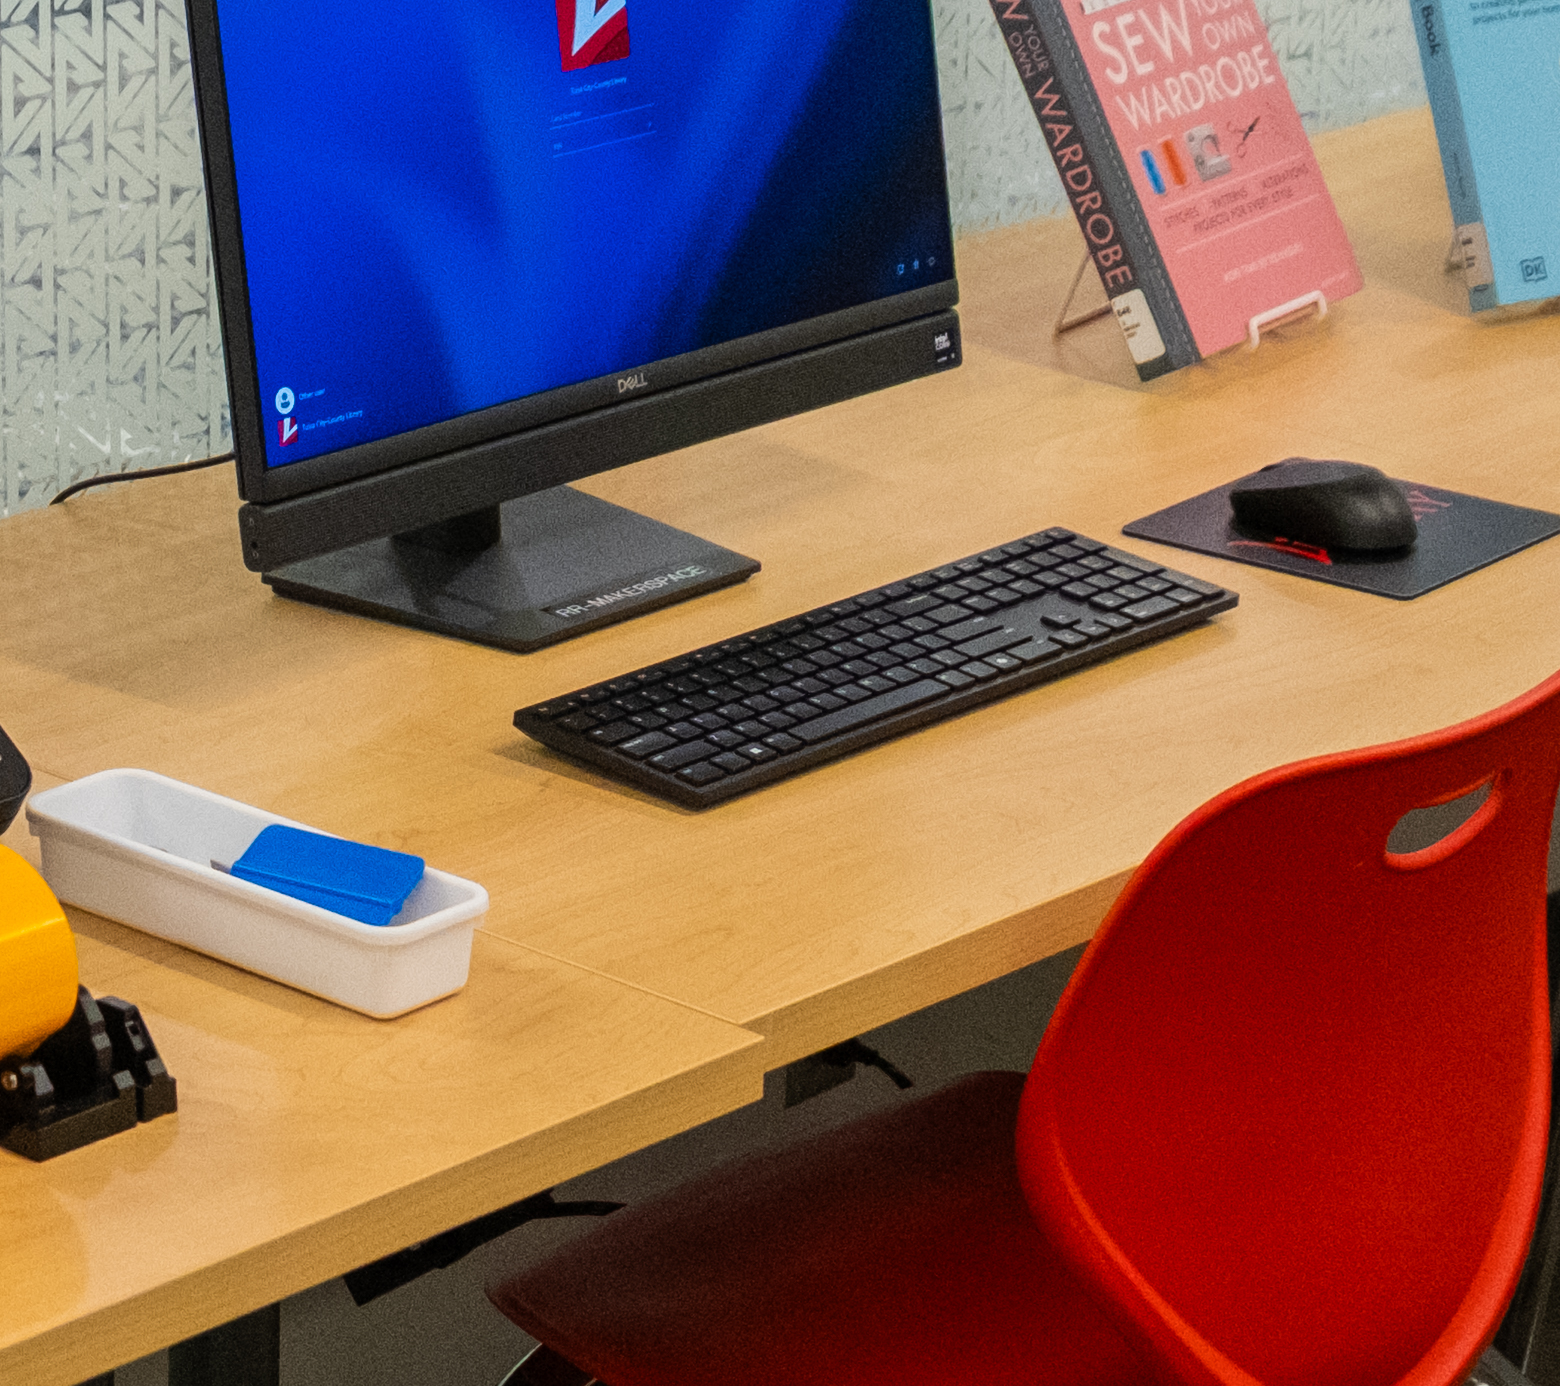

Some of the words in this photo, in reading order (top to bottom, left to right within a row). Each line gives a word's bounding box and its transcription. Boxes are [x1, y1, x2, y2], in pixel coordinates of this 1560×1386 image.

[1009, 30, 1036, 79] OWN
[1023, 25, 1050, 73] YOUR
[1202, 10, 1256, 50] OWN
[1422, 4, 1441, 56] Book
[1115, 43, 1276, 132] WARDROBE
[1034, 76, 1134, 289] WARDROBE
[617, 372, 648, 394] DELL
[555, 564, 708, 619] RR-MAKERSPACE
